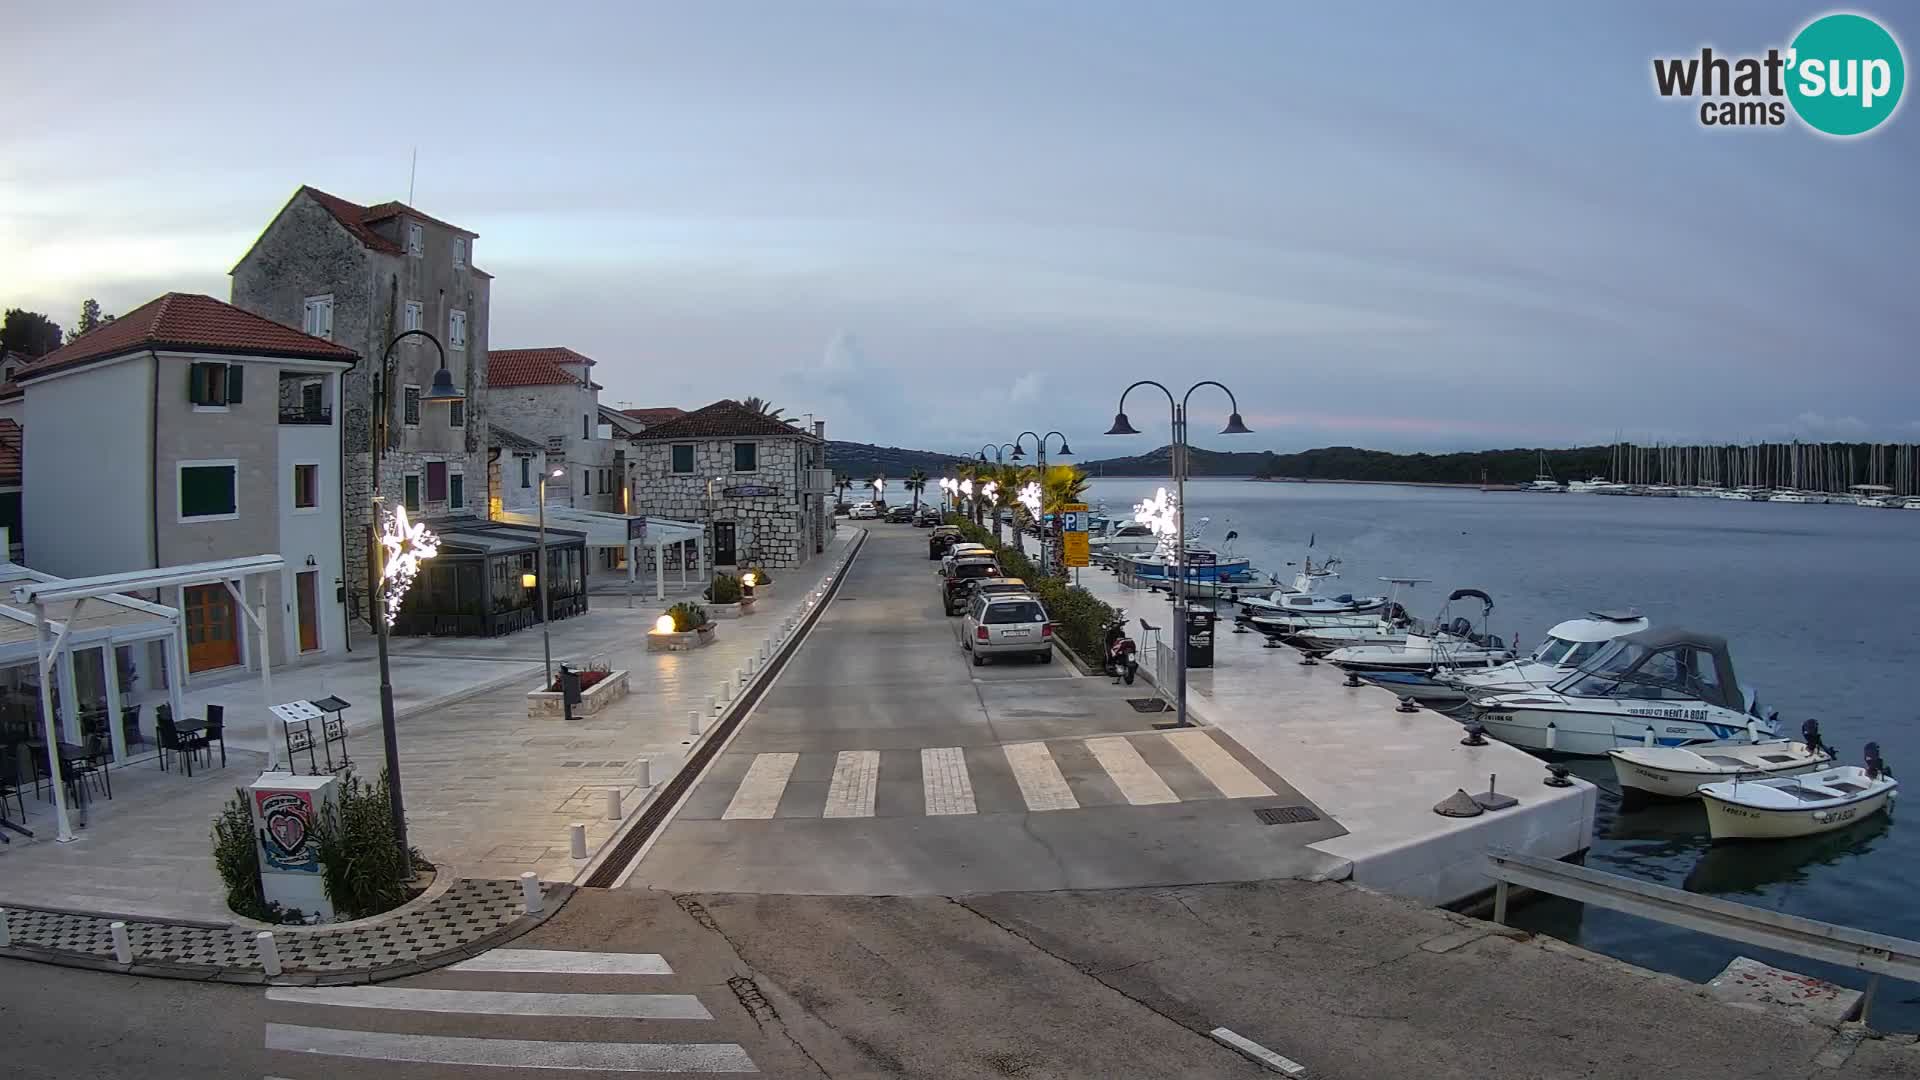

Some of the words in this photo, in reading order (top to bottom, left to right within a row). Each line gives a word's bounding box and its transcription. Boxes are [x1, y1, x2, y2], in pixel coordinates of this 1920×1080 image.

[1065, 513, 1076, 530] P
[1663, 709, 1684, 719] RENT
[1690, 710, 1709, 721] BOAT
